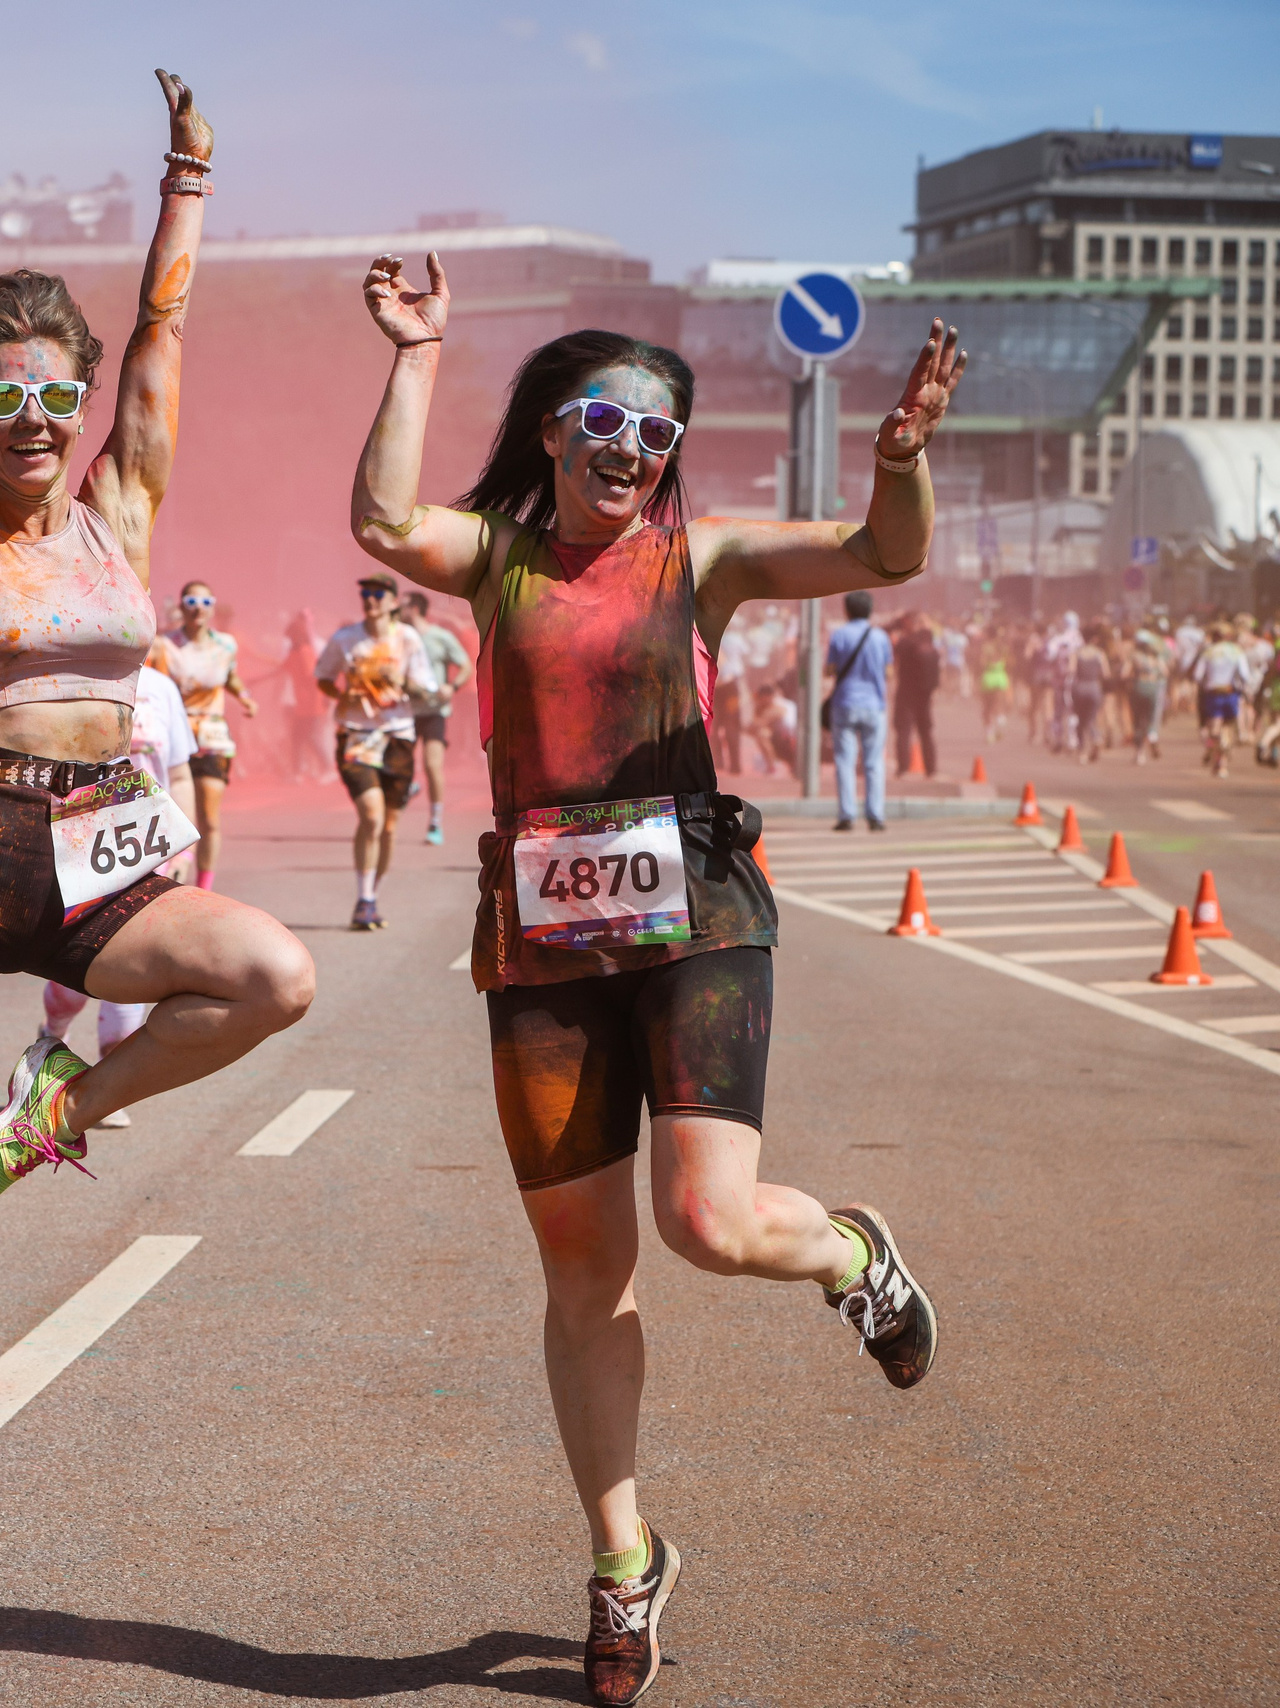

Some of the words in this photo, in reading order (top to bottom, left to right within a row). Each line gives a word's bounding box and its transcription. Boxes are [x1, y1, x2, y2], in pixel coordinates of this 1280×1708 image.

[90, 814, 171, 874] 654
[539, 851, 660, 902] 4870
[493, 889, 506, 975] KICKERS
